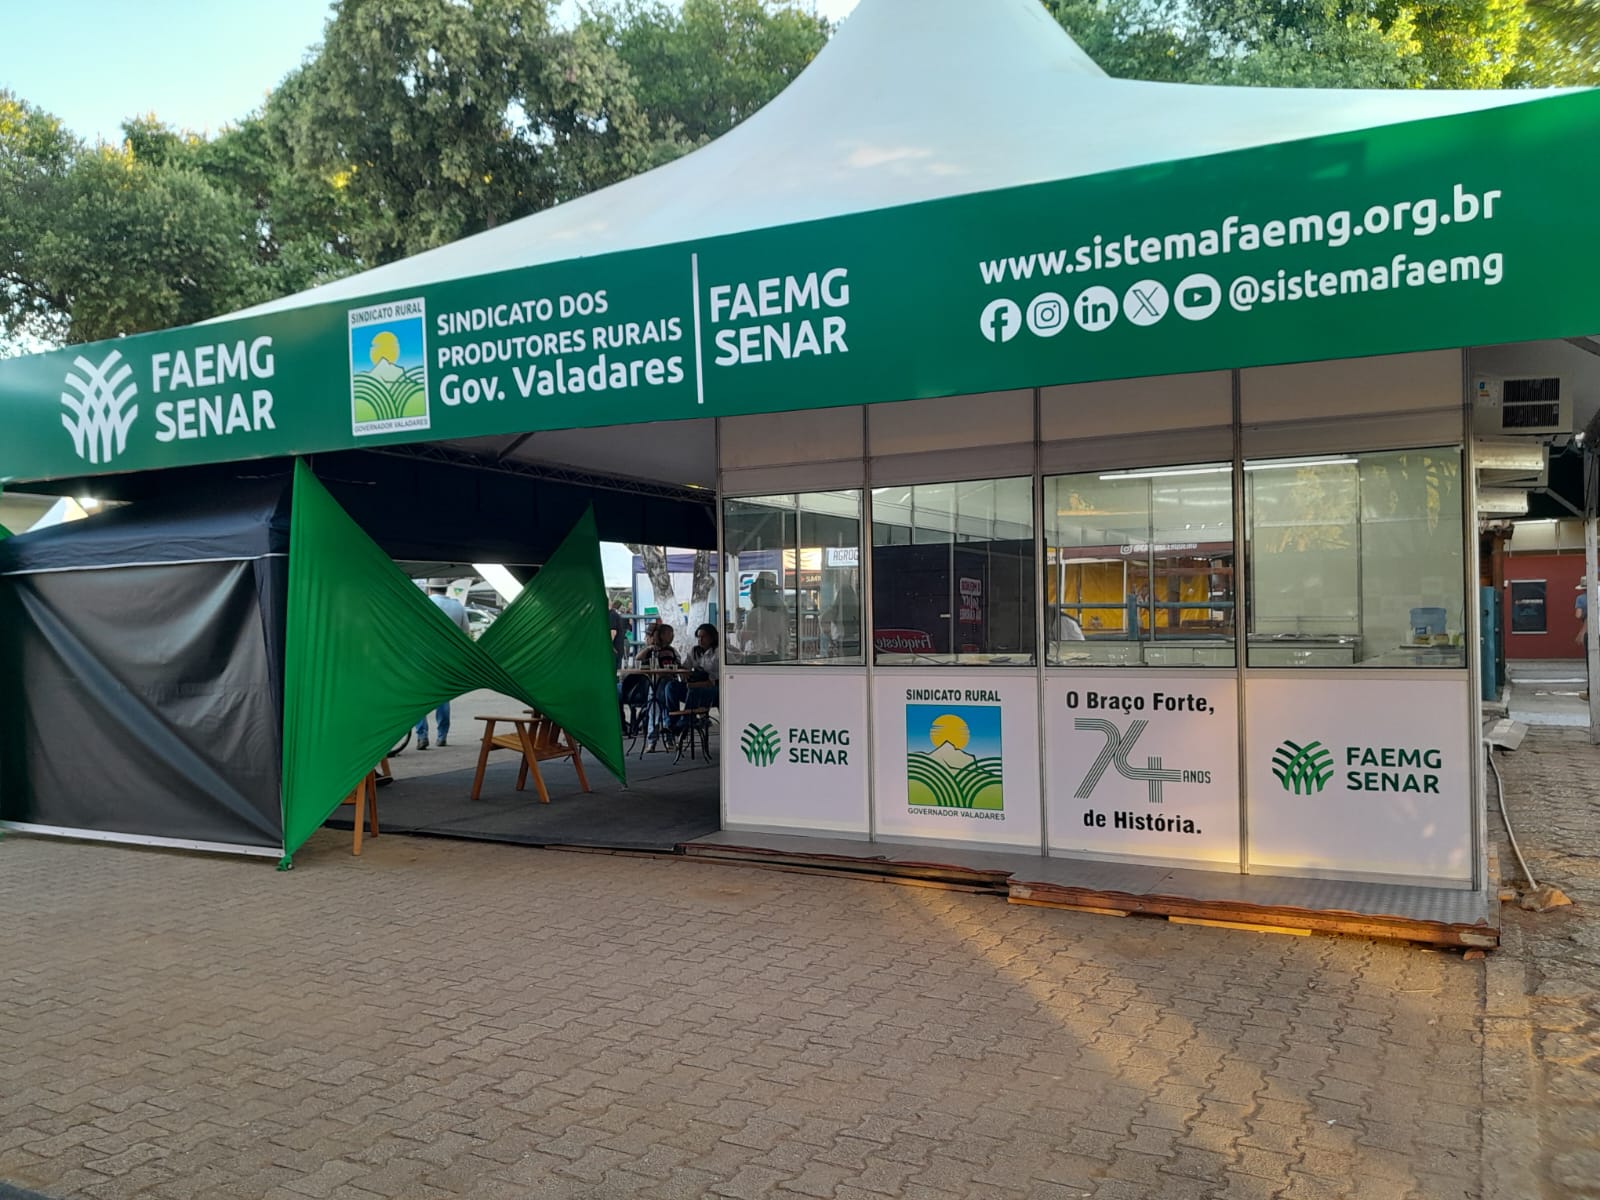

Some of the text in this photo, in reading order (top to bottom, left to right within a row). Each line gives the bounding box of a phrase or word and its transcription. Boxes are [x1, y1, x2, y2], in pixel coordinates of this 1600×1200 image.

[980, 184, 1502, 285] www.sistemafaemg.org.br
[710, 268, 849, 323] FAEMG
[1229, 252, 1504, 311] @sistemafaemg
[351, 302, 422, 324] SINDICATO RURAL
[437, 290, 608, 336] SINDICATO DOS
[438, 317, 682, 369] PRODUTORES RURAIS
[714, 316, 848, 366] SENAR
[151, 335, 275, 393] FAEMG
[439, 355, 684, 406] Gov. Valadares
[155, 389, 276, 443] SENAR
[354, 418, 428, 434] GOVERNADOR VALADARES
[906, 689, 1001, 702] SINDICATO RURAL
[1066, 691, 1215, 715] O Braço Forte,
[789, 728, 850, 746] FAEMG
[789, 748, 848, 765] SENAR
[1073, 717, 1211, 803] 74 ANOS
[1346, 747, 1442, 769] FAEMG
[1346, 771, 1440, 794] SENAR
[908, 807, 1005, 821] GOVERNADOR VALADARES
[1083, 810, 1202, 835] de História.
